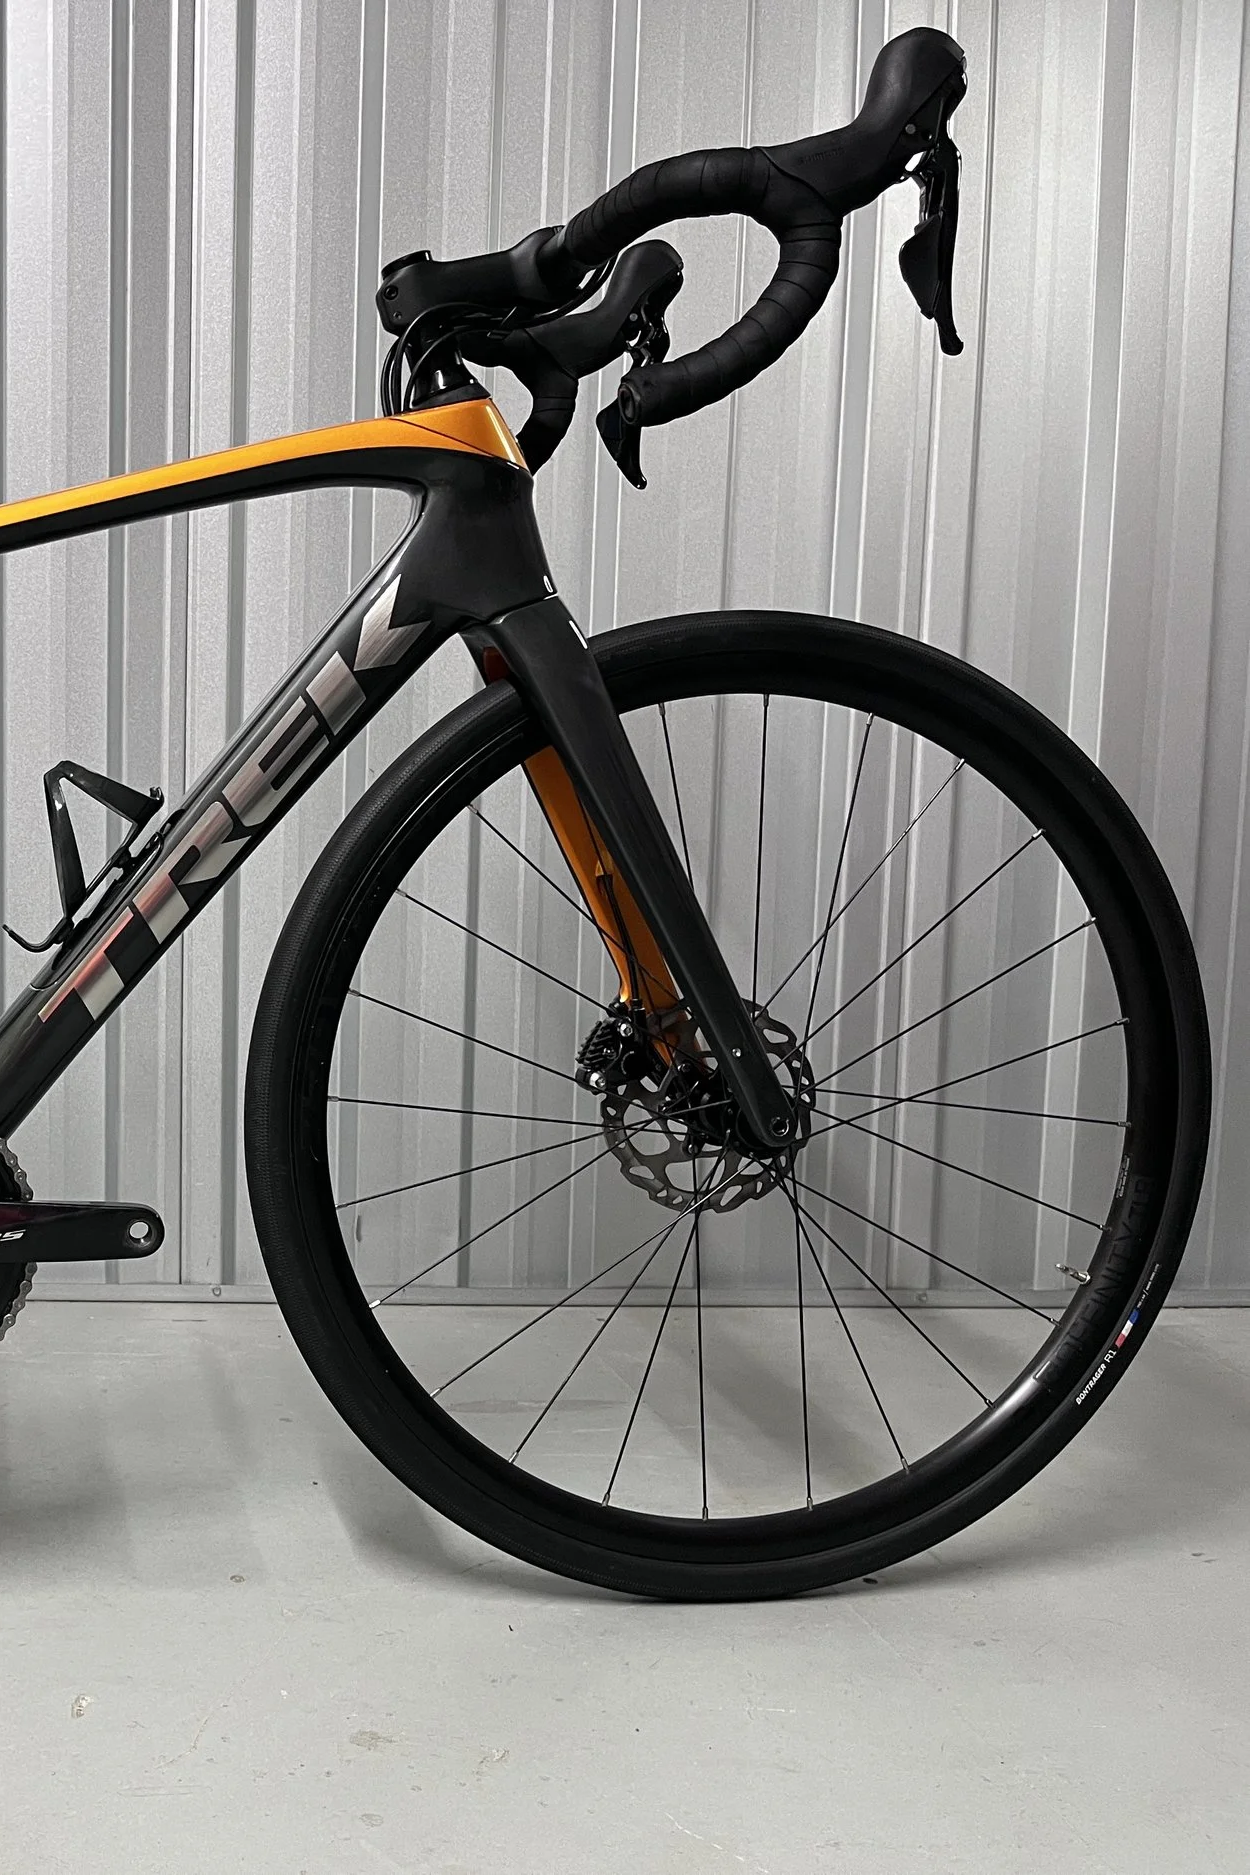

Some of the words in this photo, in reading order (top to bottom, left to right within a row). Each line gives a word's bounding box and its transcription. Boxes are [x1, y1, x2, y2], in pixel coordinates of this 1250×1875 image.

[37, 573, 432, 1023] TREK
[1075, 1363, 1107, 1405] BONTRAGER
[1103, 1349, 1117, 1363] R1
